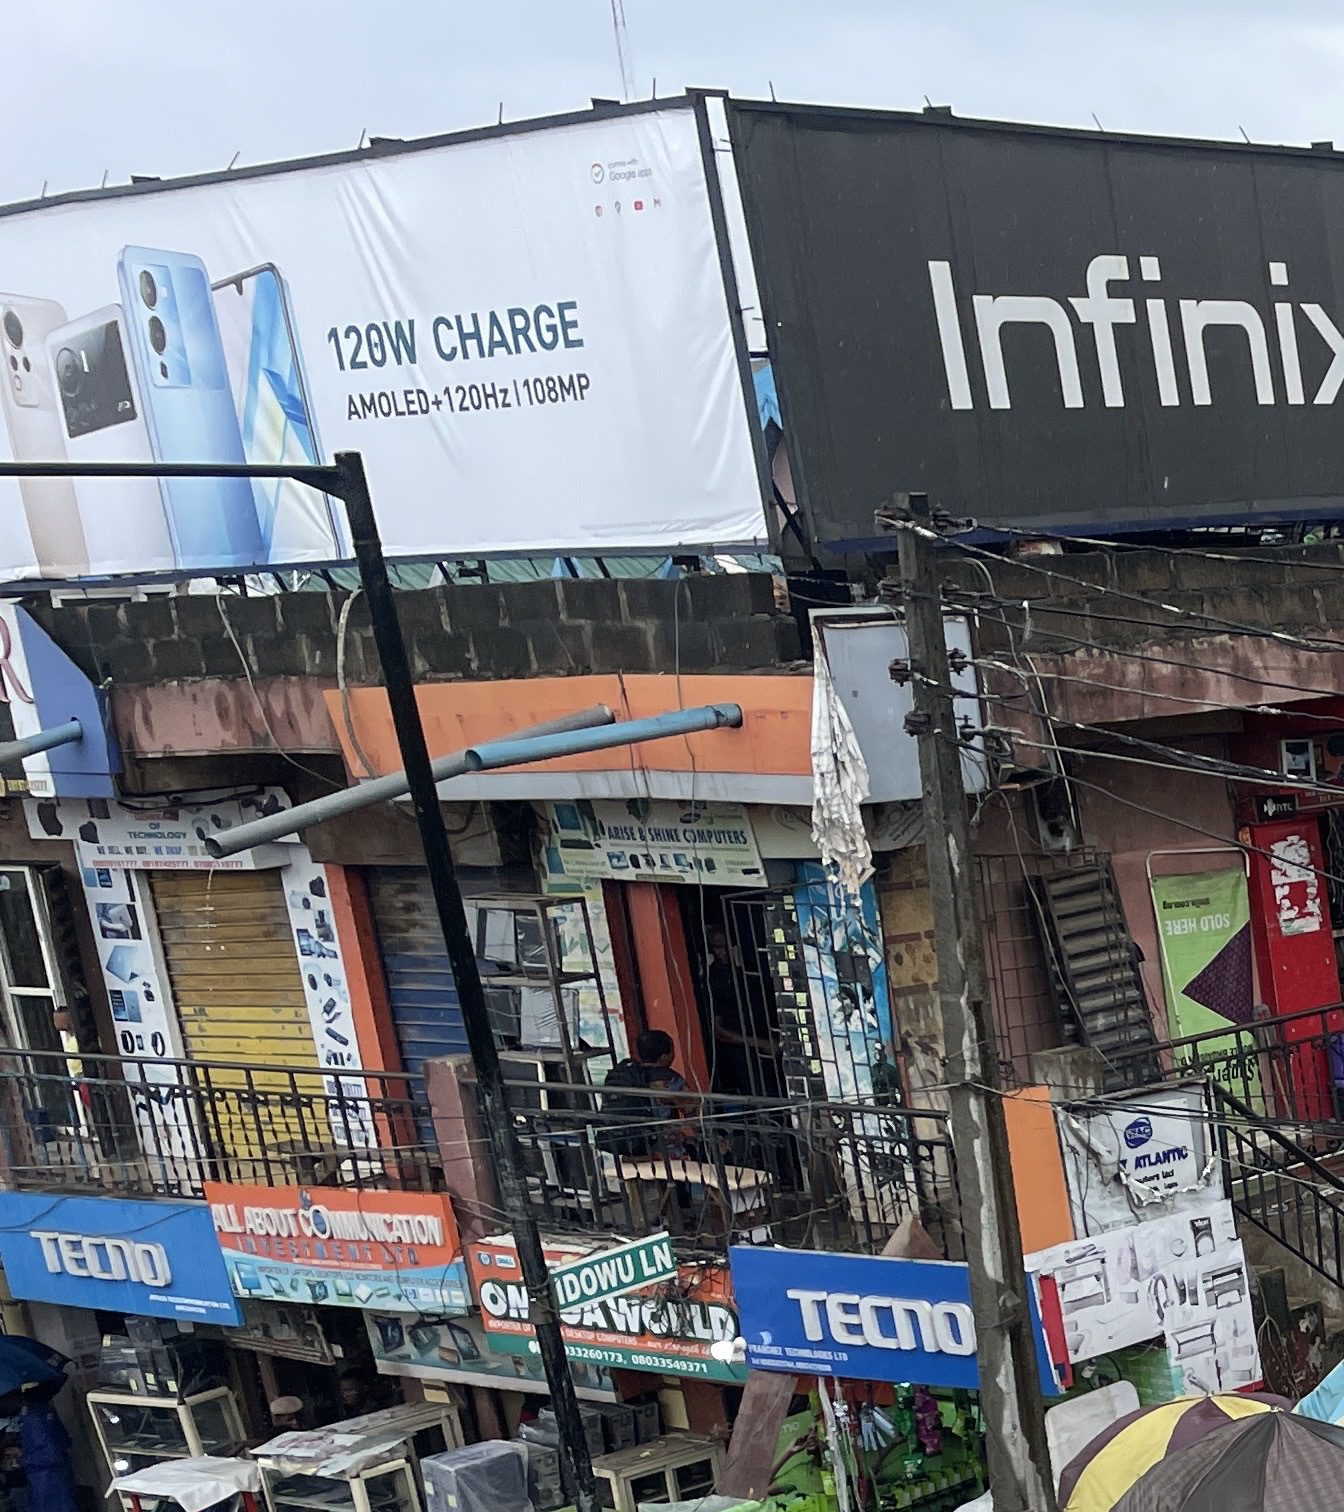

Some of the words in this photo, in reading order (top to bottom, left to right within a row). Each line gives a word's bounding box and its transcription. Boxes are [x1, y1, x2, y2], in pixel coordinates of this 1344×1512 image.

[327, 316, 417, 373] 120W
[432, 300, 585, 363] CHARGE
[608, 825, 637, 841] ARISE
[638, 825, 646, 842] &
[650, 827, 681, 843] SHINE
[683, 828, 748, 845] COMPUTERS
[1164, 917, 1197, 936] HERE
[1200, 913, 1231, 934] SOLD
[1134, 1146, 1189, 1170] ATLANTIC
[211, 1203, 244, 1233] ALL
[244, 1205, 300, 1239] ABOUT
[299, 1201, 444, 1246] COMMUNICATION
[30, 1230, 172, 1288] TECNO
[556, 1252, 635, 1306] IDOWU
[642, 1240, 674, 1278] LN
[786, 1289, 977, 1356] TECNO
[631, 1354, 708, 1374] 08033549371
[834, 1352, 848, 1361] LTD
